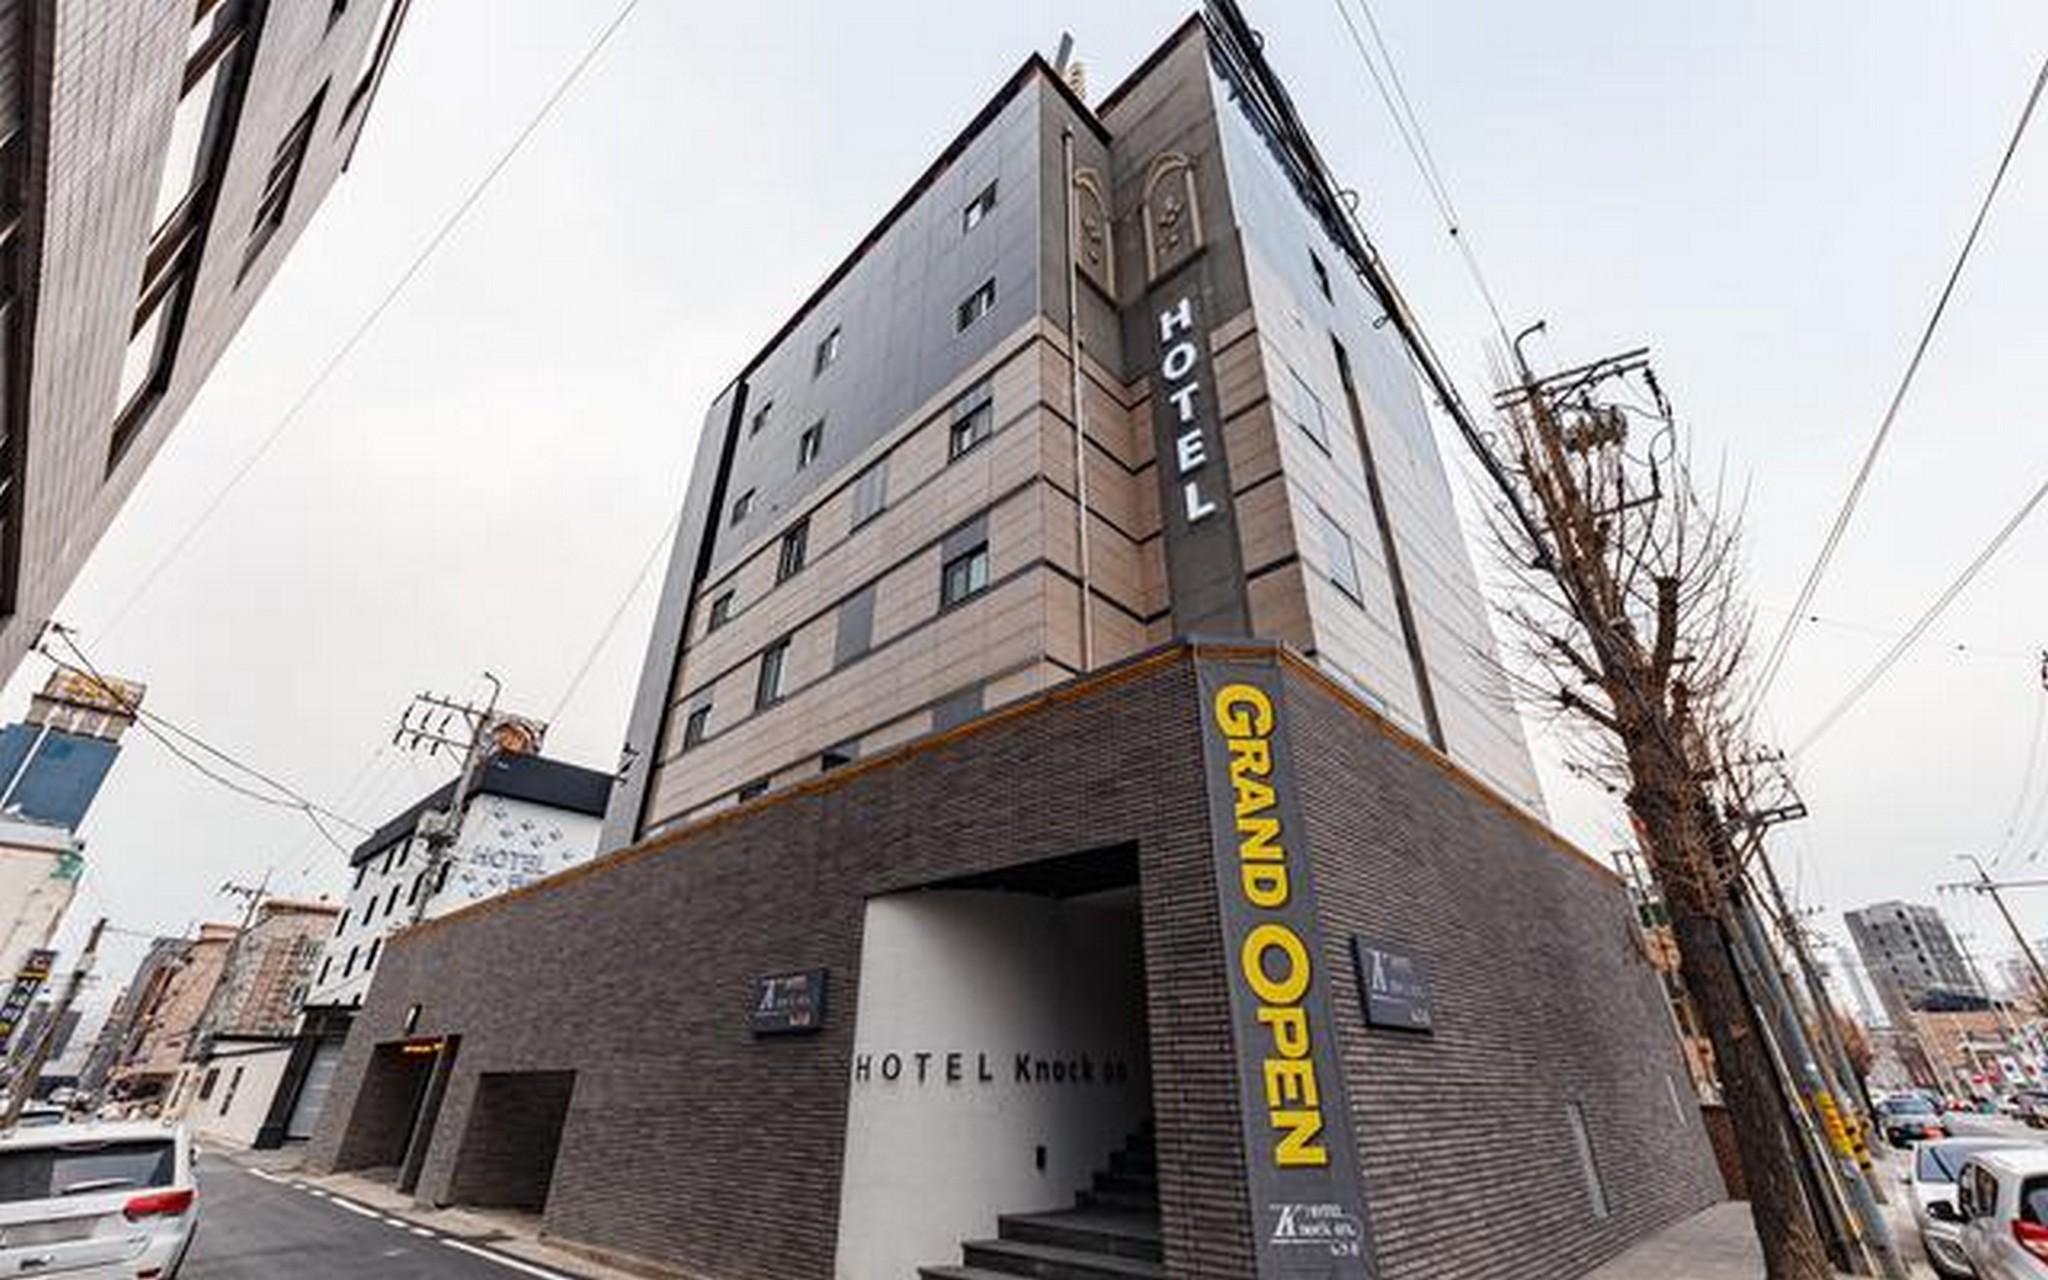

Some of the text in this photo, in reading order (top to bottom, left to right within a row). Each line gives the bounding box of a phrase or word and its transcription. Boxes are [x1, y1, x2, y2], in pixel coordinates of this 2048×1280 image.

[1159, 297, 1217, 523] HOTEL
[471, 845, 547, 875] HOTEL
[1214, 683, 1328, 1167] GRAND OPEN
[855, 1052, 994, 1084] HOTEL
[1014, 1050, 1096, 1084] Knock
